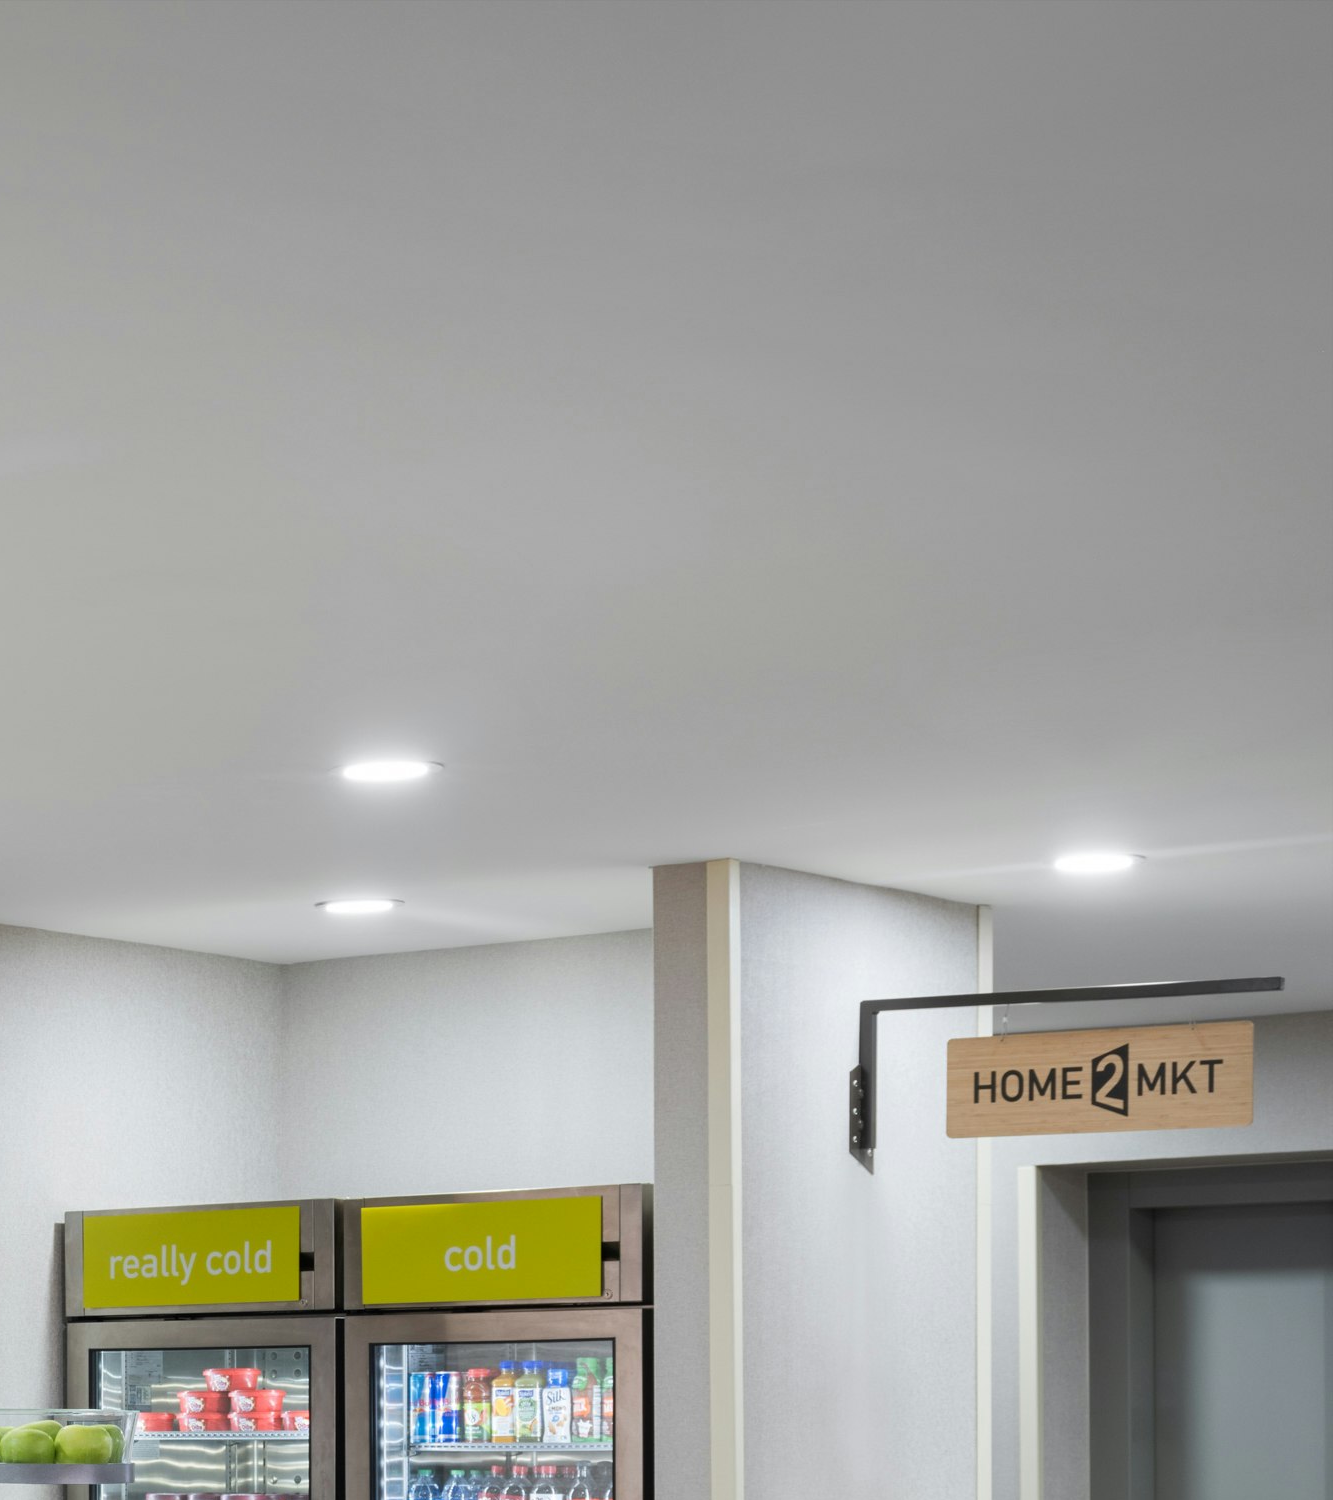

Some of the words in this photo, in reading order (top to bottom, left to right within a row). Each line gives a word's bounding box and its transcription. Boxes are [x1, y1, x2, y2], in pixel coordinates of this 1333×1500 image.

[973, 1066, 1083, 1104] HOME
[1094, 1051, 1126, 1113] 2
[1137, 1059, 1223, 1096] MKT
[108, 1244, 197, 1285] really
[206, 1240, 272, 1276] cold
[444, 1234, 517, 1273] cold
[546, 1390, 566, 1405] Silk
